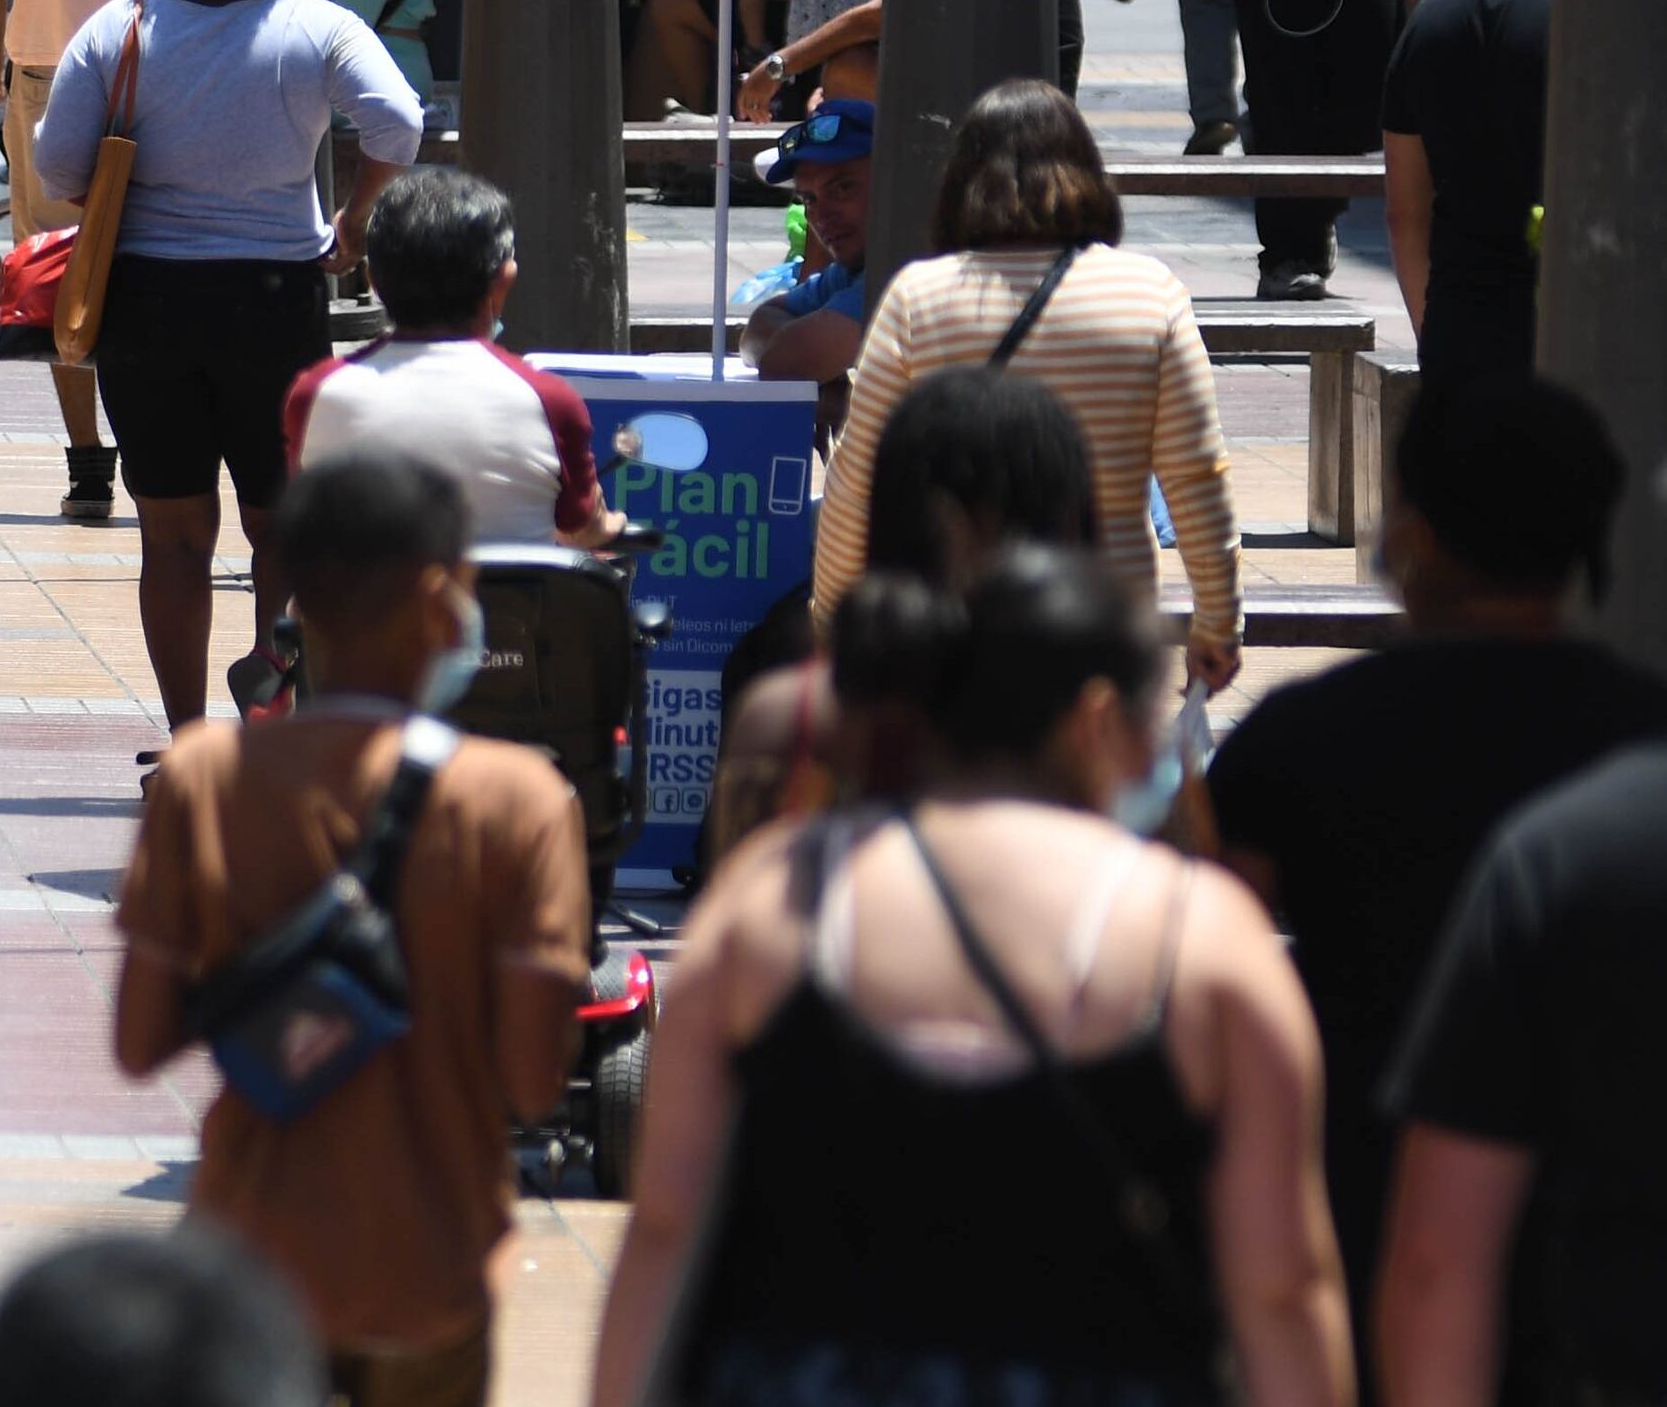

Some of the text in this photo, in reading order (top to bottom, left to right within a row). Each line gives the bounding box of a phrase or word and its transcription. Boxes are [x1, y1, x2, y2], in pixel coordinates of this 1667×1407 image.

[615, 460, 759, 516] Plan
[641, 518, 769, 580] ácil
[645, 716, 719, 747] inut
